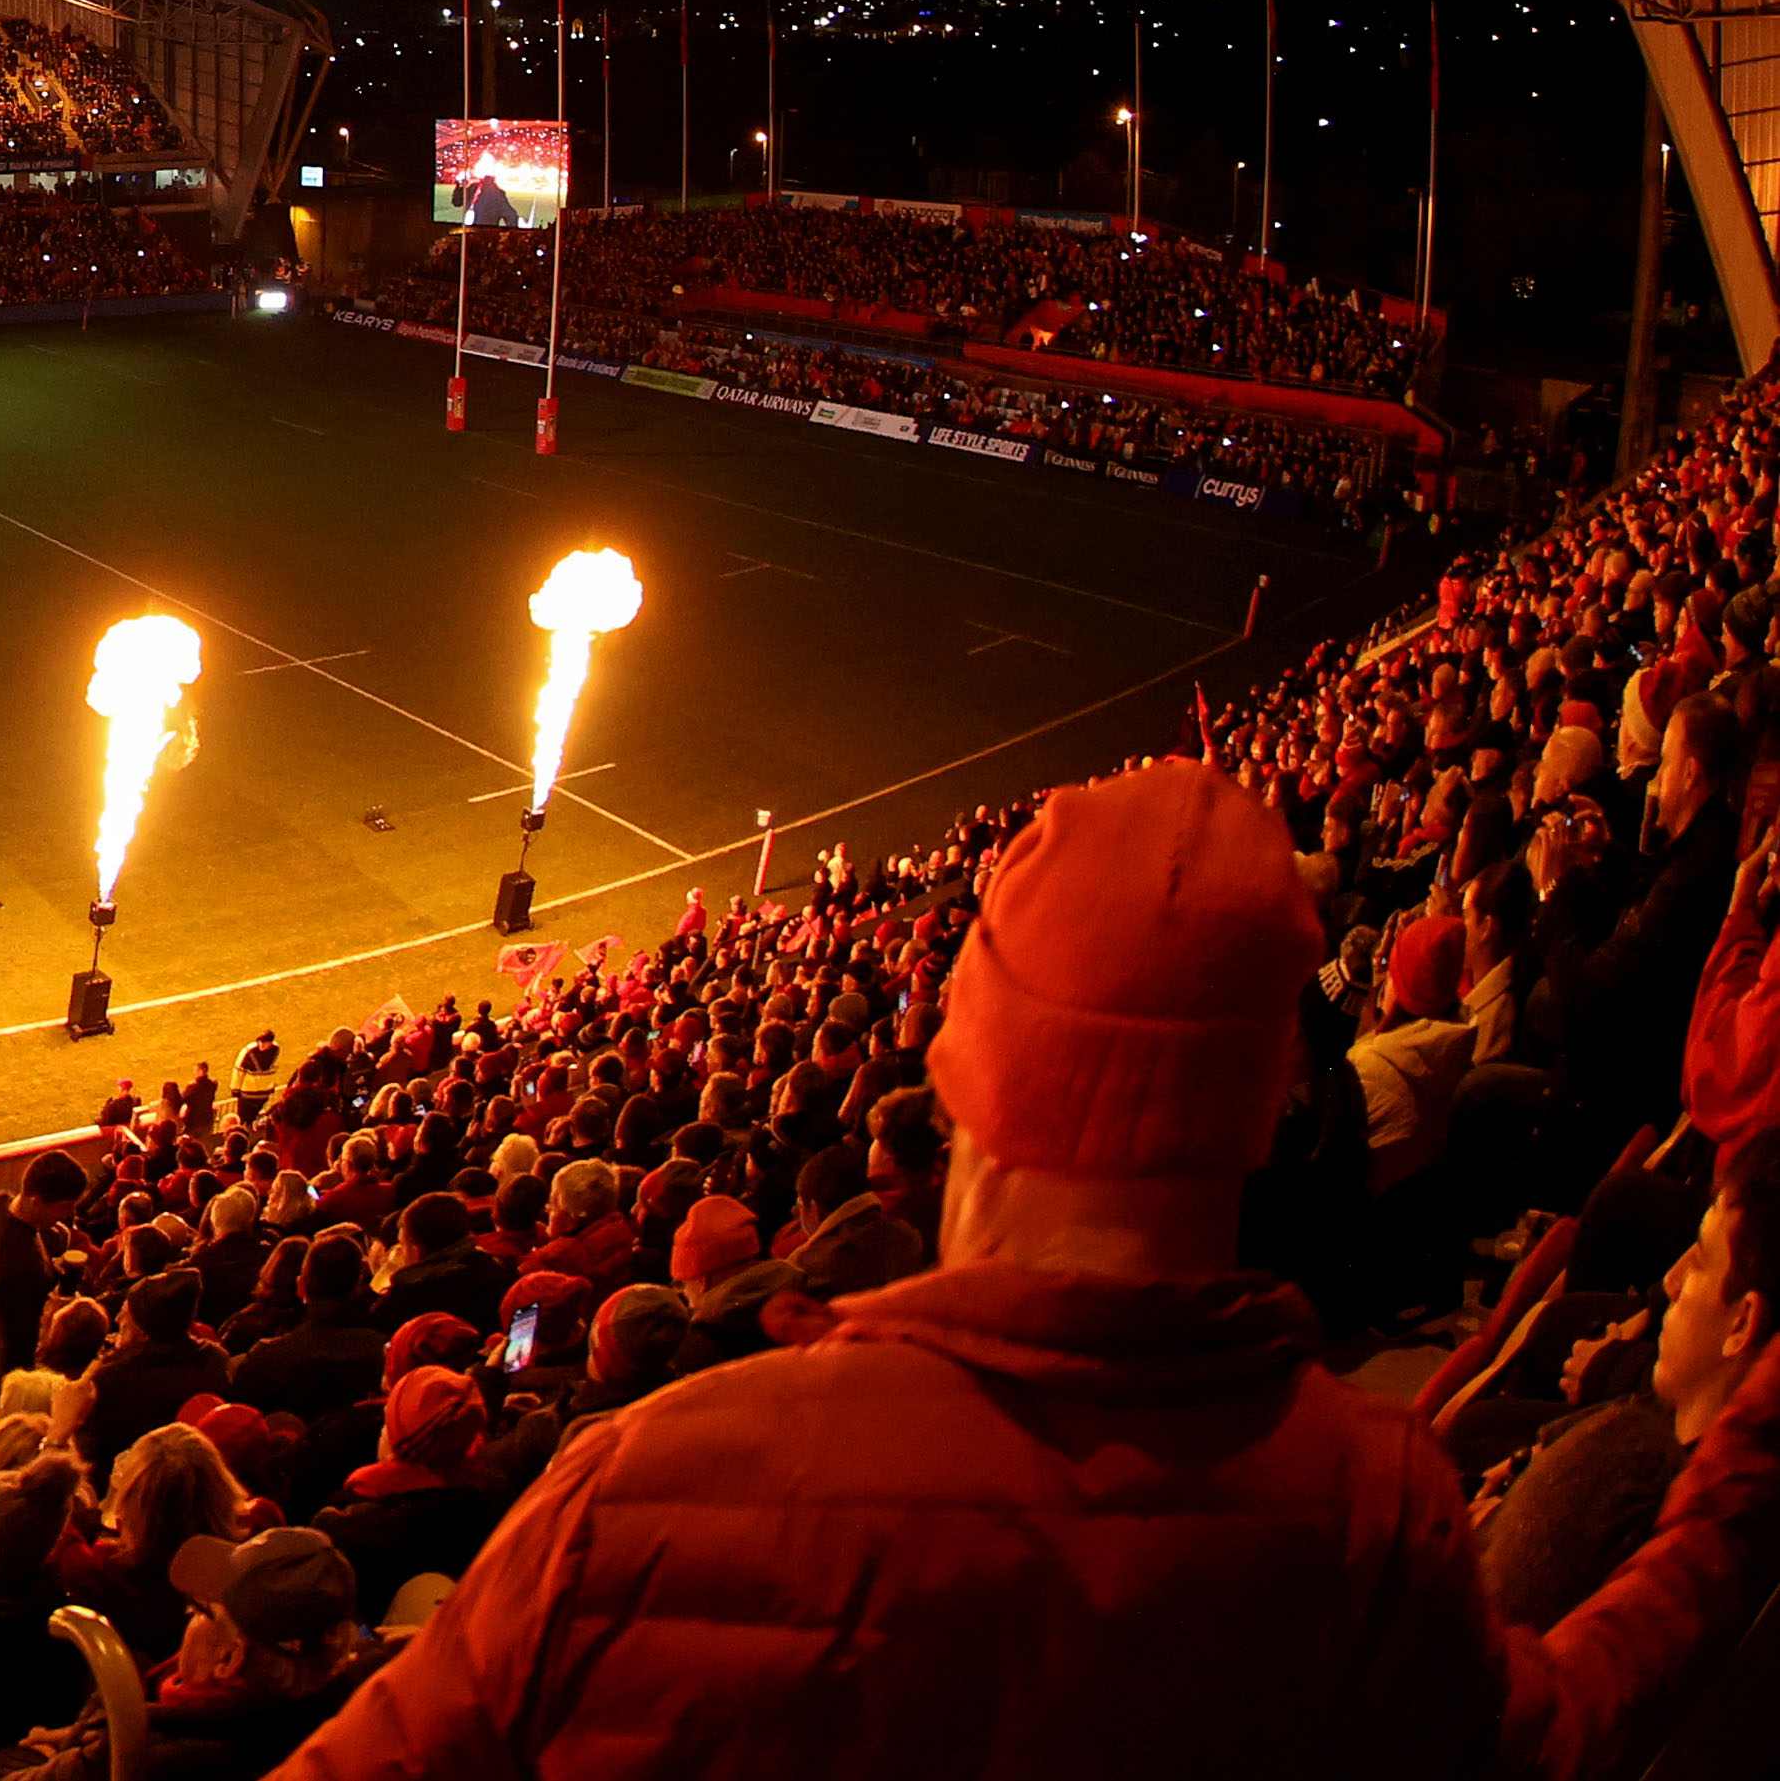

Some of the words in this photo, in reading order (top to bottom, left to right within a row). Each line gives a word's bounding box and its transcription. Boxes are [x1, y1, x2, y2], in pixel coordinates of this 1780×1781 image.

[332, 309, 395, 331] KEARYS
[716, 384, 756, 407] QATAR
[757, 392, 814, 417] AIRWAYS
[931, 425, 953, 442] LIFE
[953, 430, 986, 449] STYLE
[985, 436, 1031, 458] SPORTS
[1051, 453, 1097, 472] GUINNESS
[1114, 466, 1160, 485] GUINNESS
[1202, 477, 1261, 507] currys
